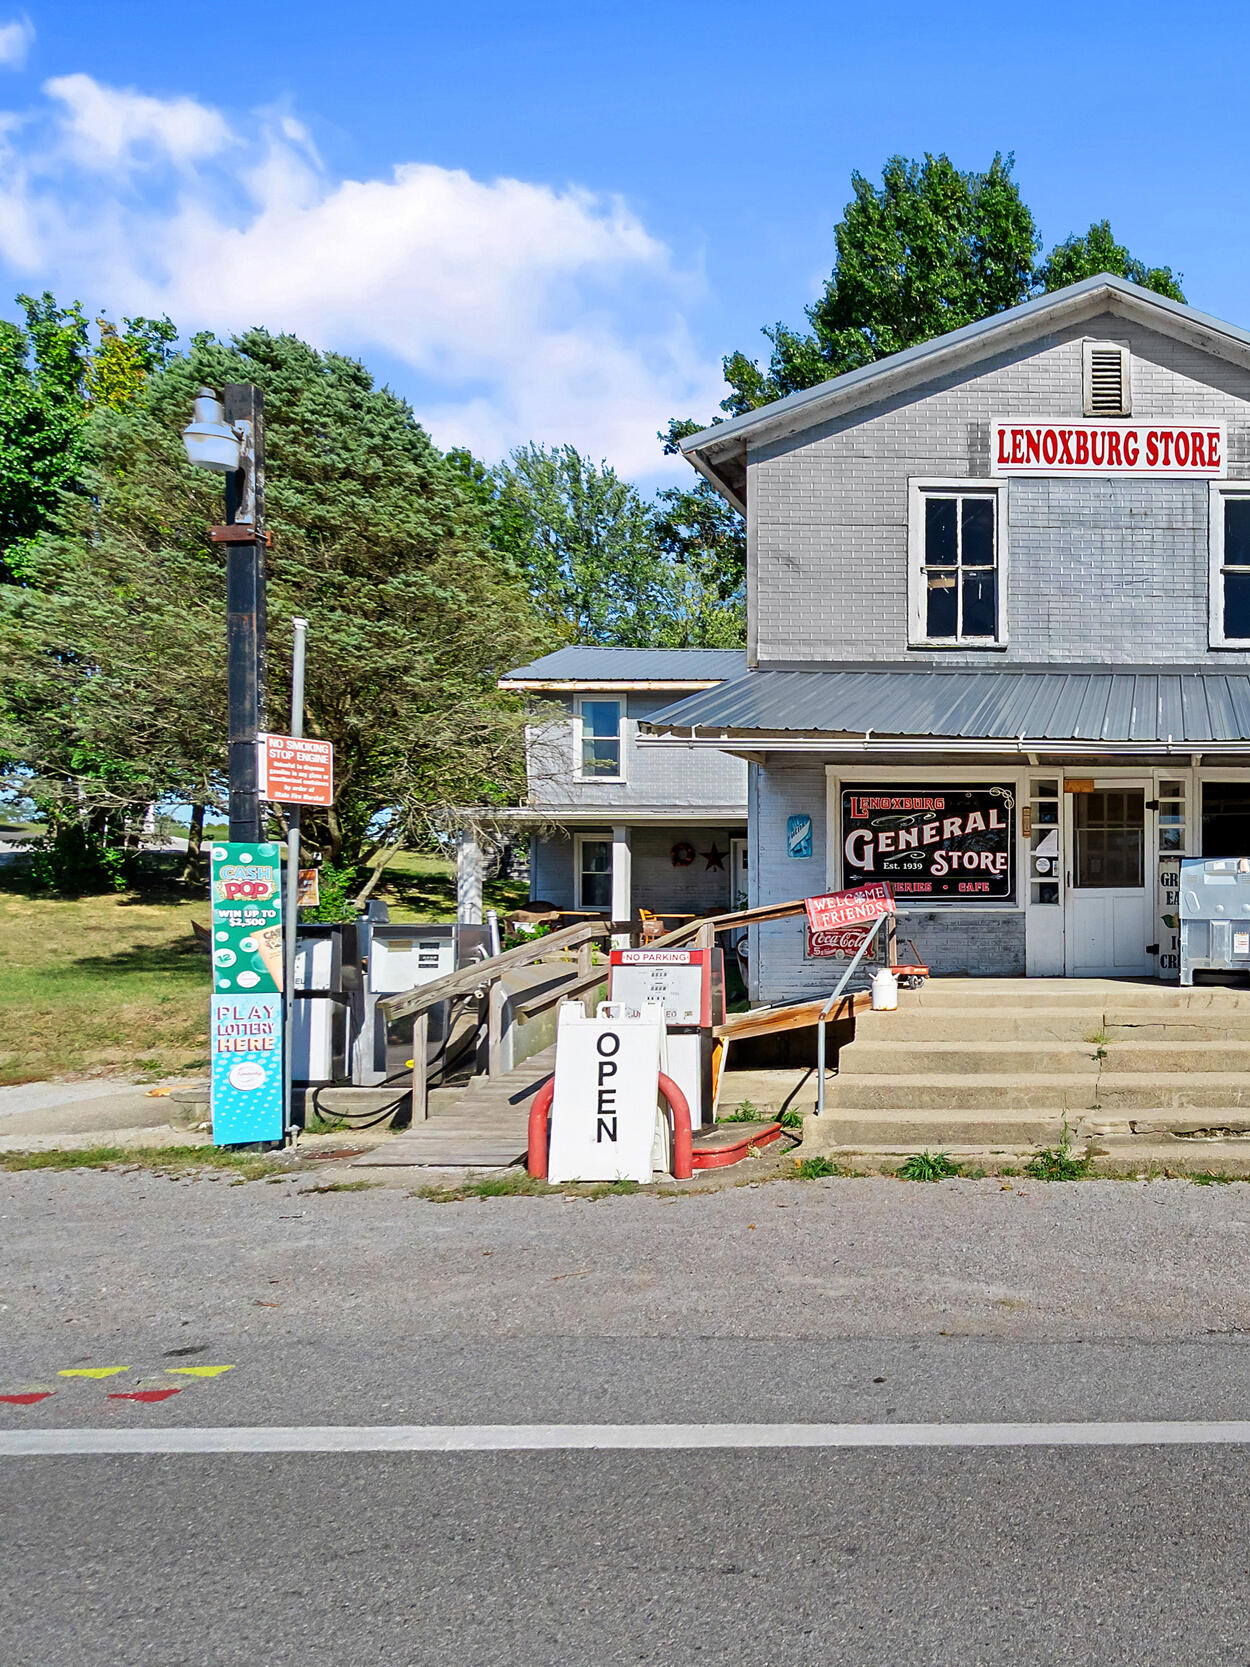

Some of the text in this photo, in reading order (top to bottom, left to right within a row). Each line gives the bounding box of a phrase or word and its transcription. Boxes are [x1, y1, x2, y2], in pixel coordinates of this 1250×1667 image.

[997, 429, 1221, 467] LENOXBURG STORE
[269, 738, 329, 754] NO SMOKING
[269, 749, 329, 764] STOP ENGINE
[845, 809, 1007, 872] GENERAL
[883, 862, 923, 870] Est. 1939
[930, 850, 1008, 876] STORE
[221, 866, 271, 880] CASH
[224, 881, 269, 900] POP
[958, 882, 990, 892] CAFE
[218, 910, 277, 918] WIN UP TO
[821, 901, 884, 927] FRIENDS
[229, 918, 266, 927] $2,500
[626, 953, 687, 961] NO PARKING
[217, 1005, 274, 1020] PLAY
[217, 1022, 274, 1036] LOTTERY
[217, 1038, 276, 1053] HERE
[597, 1032, 620, 1143] OPEN
